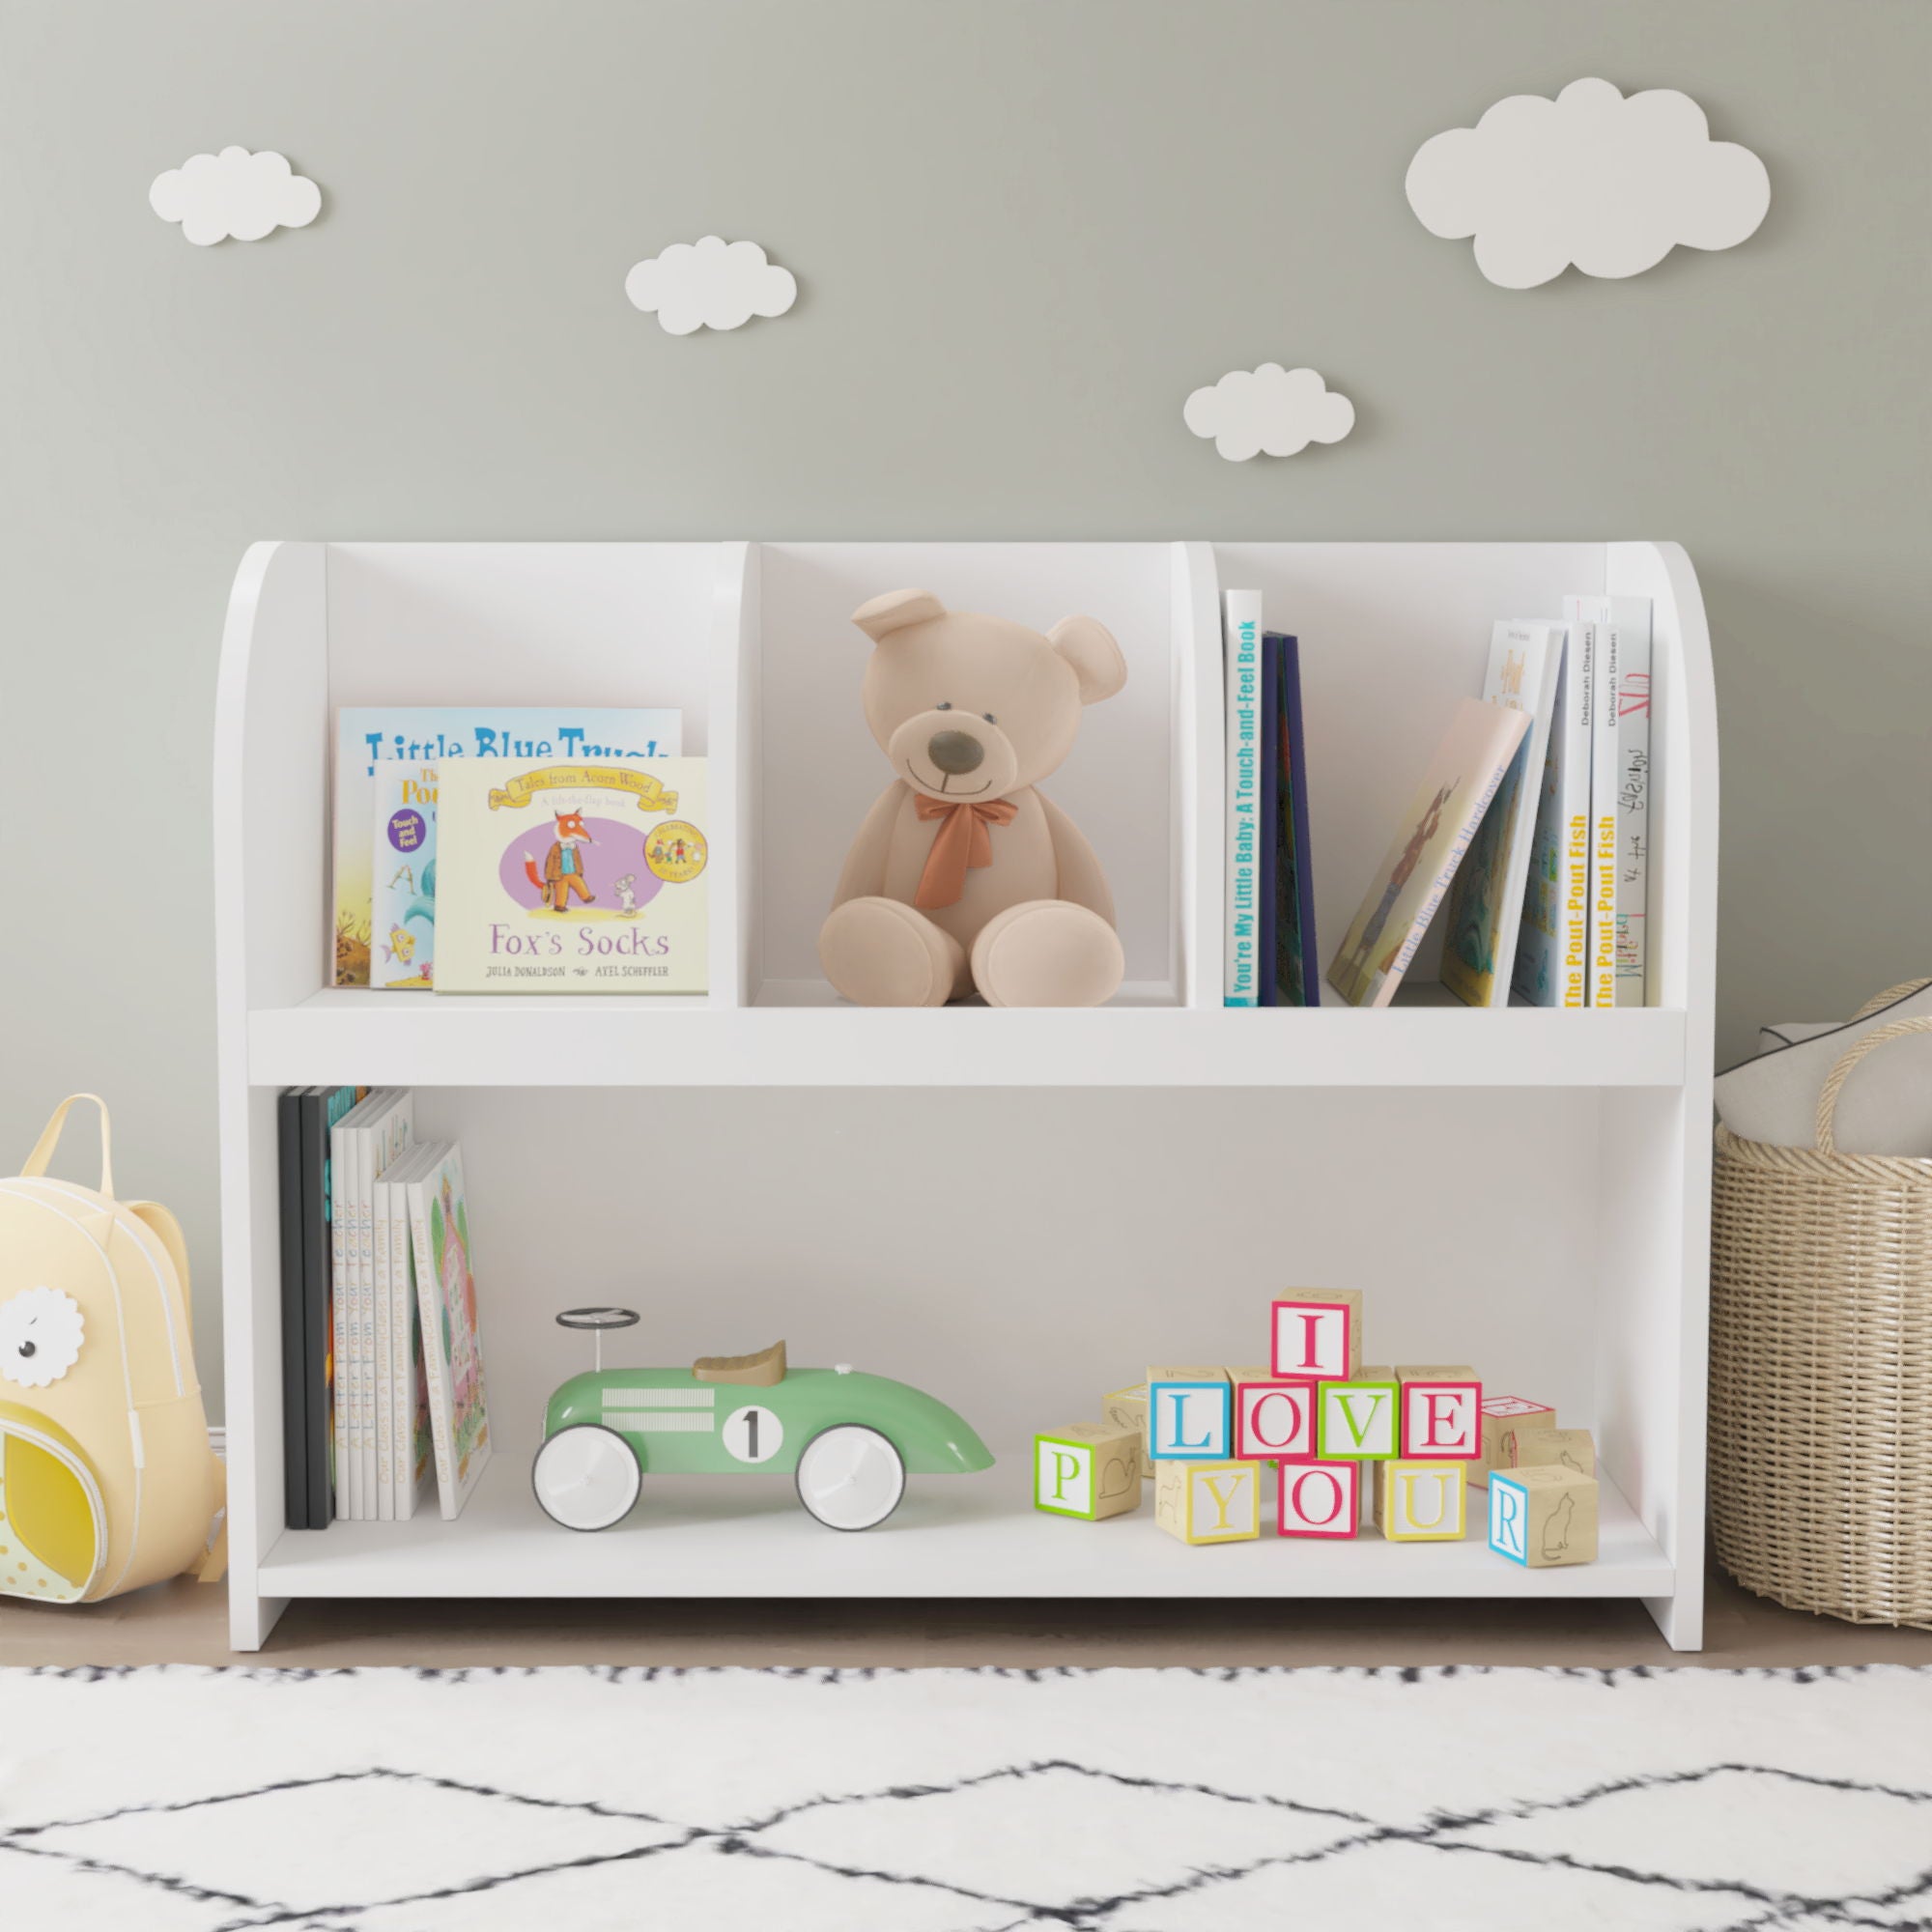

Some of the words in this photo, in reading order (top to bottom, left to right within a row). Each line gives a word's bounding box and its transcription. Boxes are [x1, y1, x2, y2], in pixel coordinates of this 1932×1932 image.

[1237, 620, 1256, 663] Book
[1582, 632, 1592, 673] Diesen
[1608, 633, 1618, 674] Diesen
[1581, 675, 1591, 726] Deborah
[1607, 675, 1617, 727] Deborah
[1236, 668, 1256, 799] Touch-and-Feel
[420, 768, 439, 782] Th
[517, 776, 545, 793] Tales
[550, 771, 577, 784] from
[581, 769, 615, 784] Acorn
[617, 771, 652, 793] Wood
[392, 815, 418, 830] Touch
[1236, 802, 1253, 812] A
[398, 826, 415, 838] and
[399, 837, 417, 848] Feel
[1235, 817, 1255, 863] Baby:
[1569, 814, 1586, 858] Fish
[1597, 816, 1615, 859] Fish
[1235, 867, 1253, 909] Little
[1234, 913, 1254, 937] My
[1566, 865, 1585, 966] Pout-Pout
[1597, 865, 1614, 967] Pout-Pout
[488, 923, 563, 955] Fox's
[578, 925, 670, 956] Socks
[486, 966, 512, 978] JULIA
[514, 966, 566, 978] DONALDSON
[594, 966, 619, 977] AXEL
[621, 965, 669, 978] SCHEFFLER
[1233, 941, 1253, 993] You're
[1296, 1314, 1325, 1369] I
[741, 1410, 759, 1459] 1
[1051, 1451, 1081, 1501] P
[1496, 1489, 1522, 1553] R
